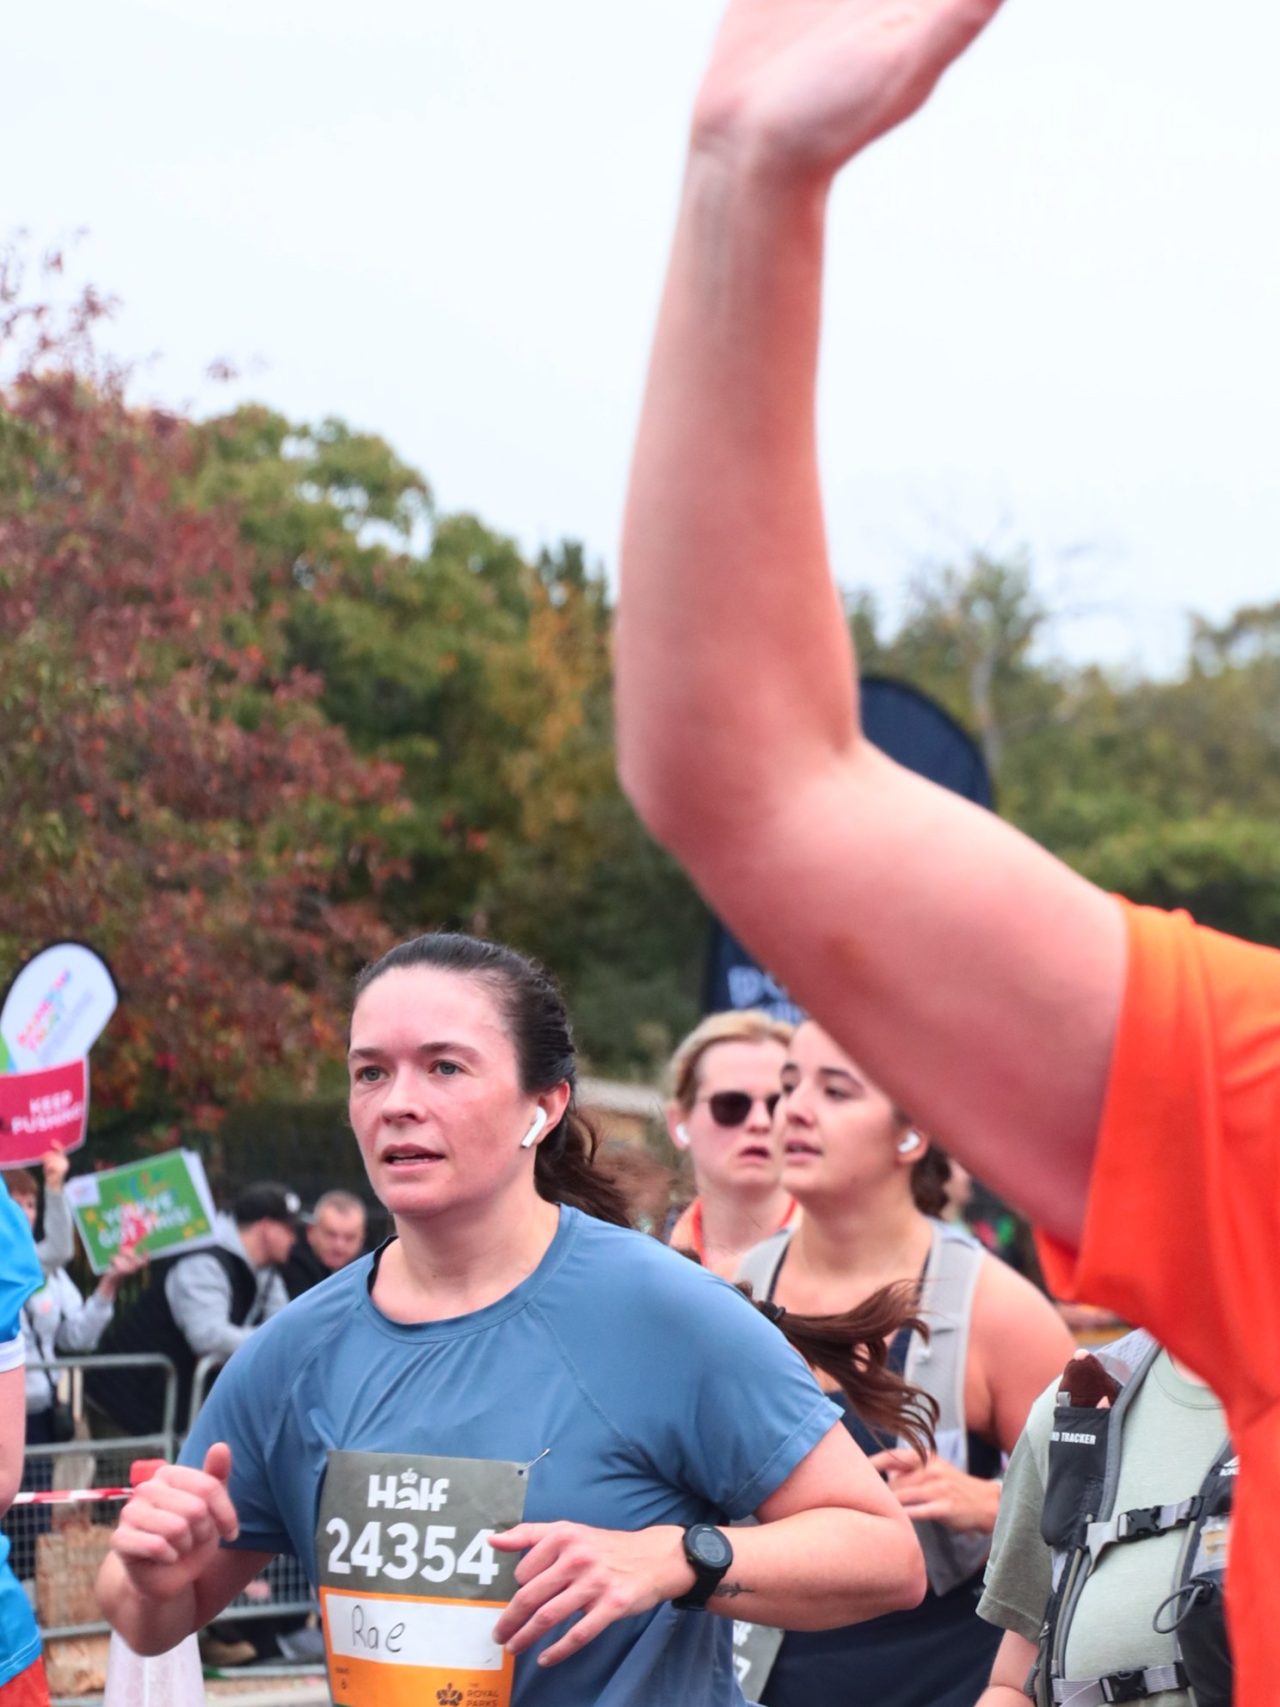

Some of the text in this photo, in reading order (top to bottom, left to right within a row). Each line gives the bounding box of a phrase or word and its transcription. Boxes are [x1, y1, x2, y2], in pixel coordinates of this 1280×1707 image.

[29, 1089, 73, 1116] KEEP
[1061, 1432, 1096, 1445] TRACKER
[367, 1474, 450, 1512] Half
[325, 1517, 500, 1585] 24354
[352, 1605, 405, 1653] Rae
[467, 1690, 499, 1698] ROYAL
